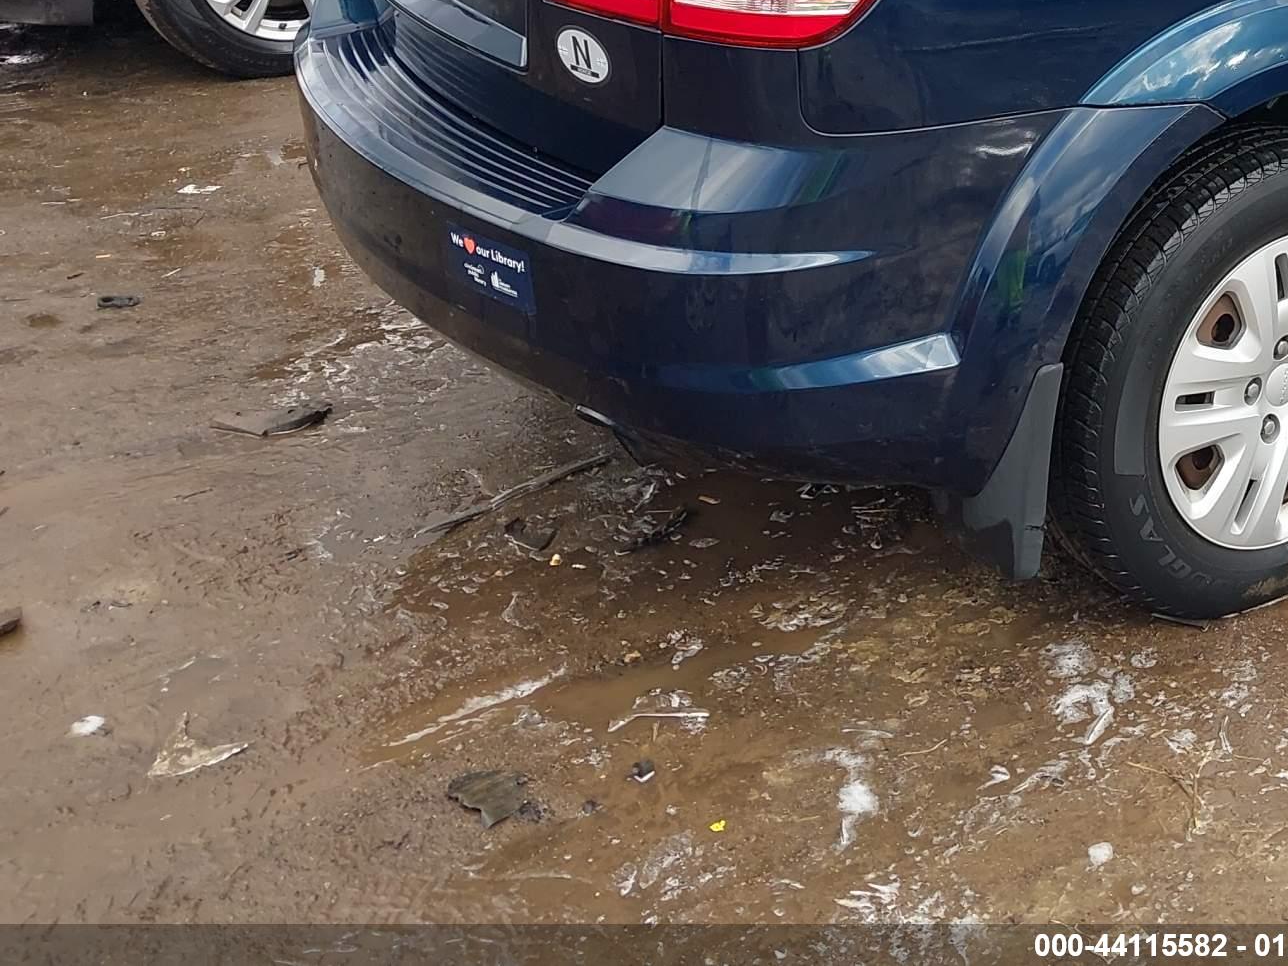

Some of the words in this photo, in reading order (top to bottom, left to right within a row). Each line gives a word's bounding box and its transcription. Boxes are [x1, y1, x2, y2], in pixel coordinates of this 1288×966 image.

[571, 35, 592, 70] N
[450, 232, 464, 248] We
[475, 246, 490, 259] our
[490, 249, 526, 274] Library!
